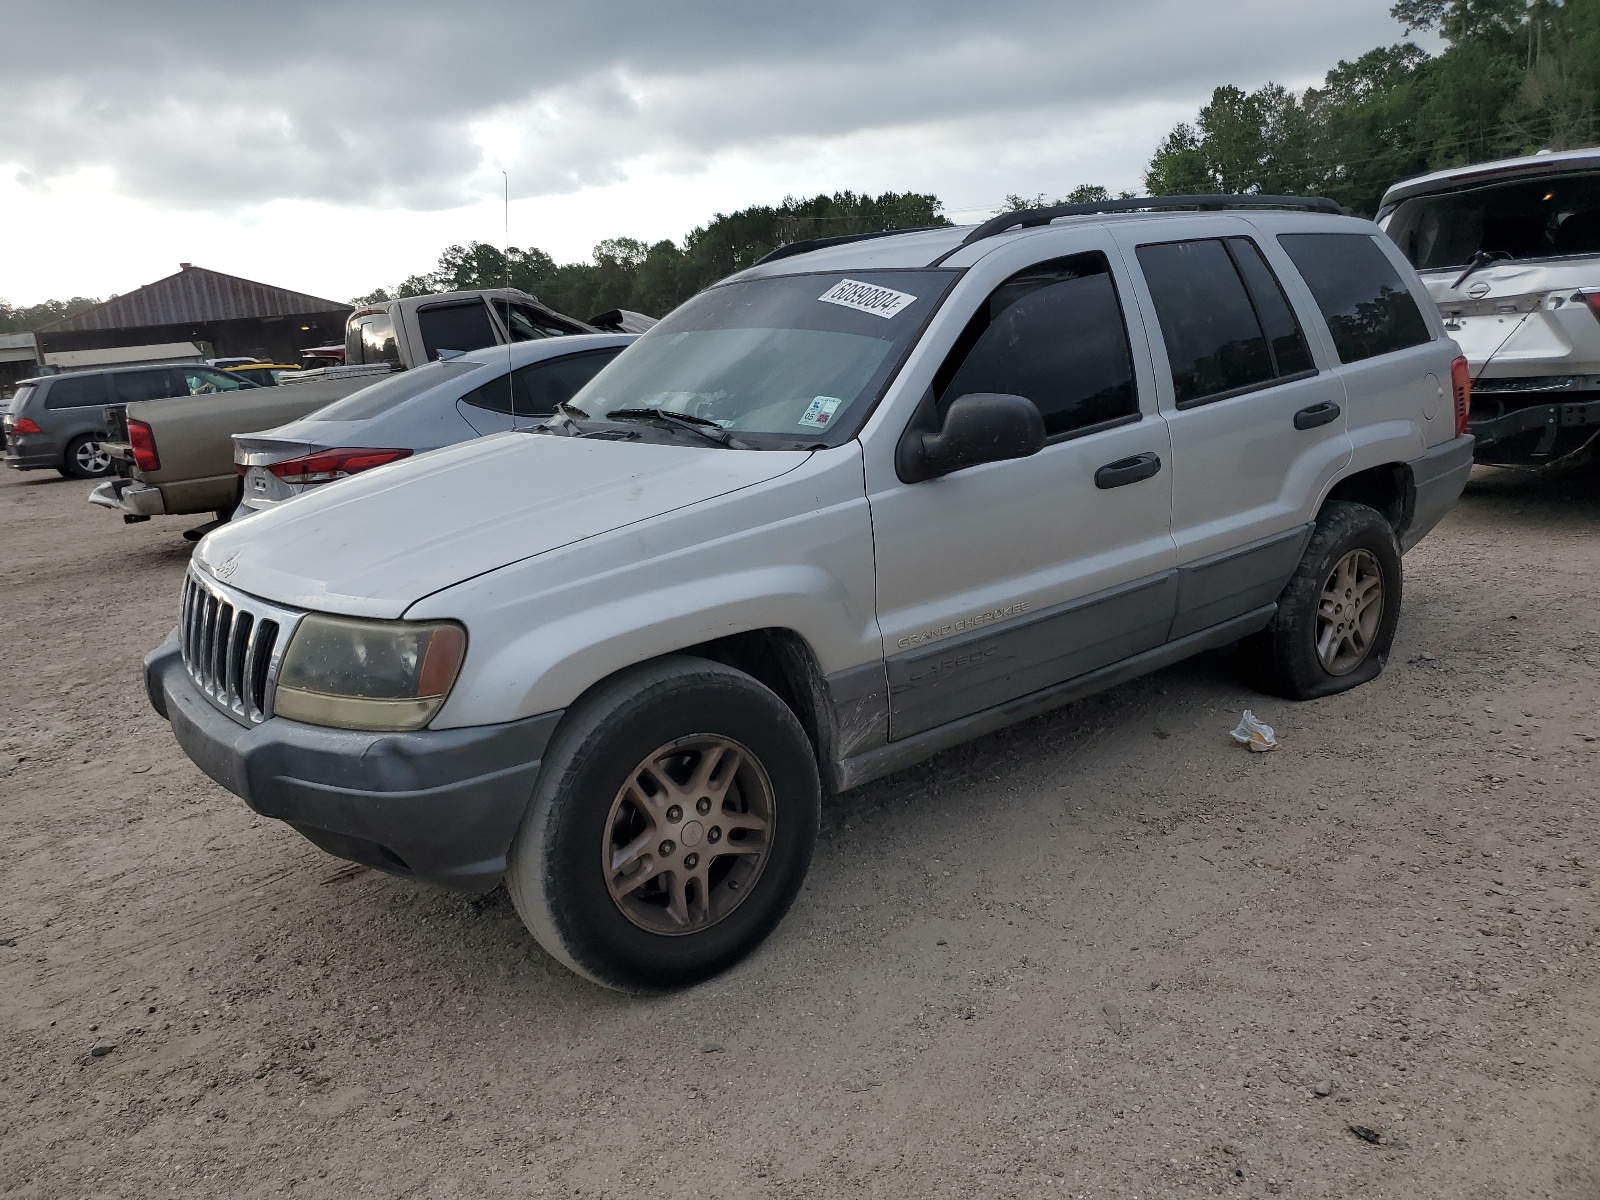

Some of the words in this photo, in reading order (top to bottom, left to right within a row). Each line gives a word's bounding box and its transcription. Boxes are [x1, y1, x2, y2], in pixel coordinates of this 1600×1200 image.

[831, 282, 901, 311] 60890804
[804, 412, 816, 421] 05
[897, 625, 950, 649] GRAND
[954, 601, 1031, 631] CHEROKEE
[909, 646, 998, 682] LAREDO
